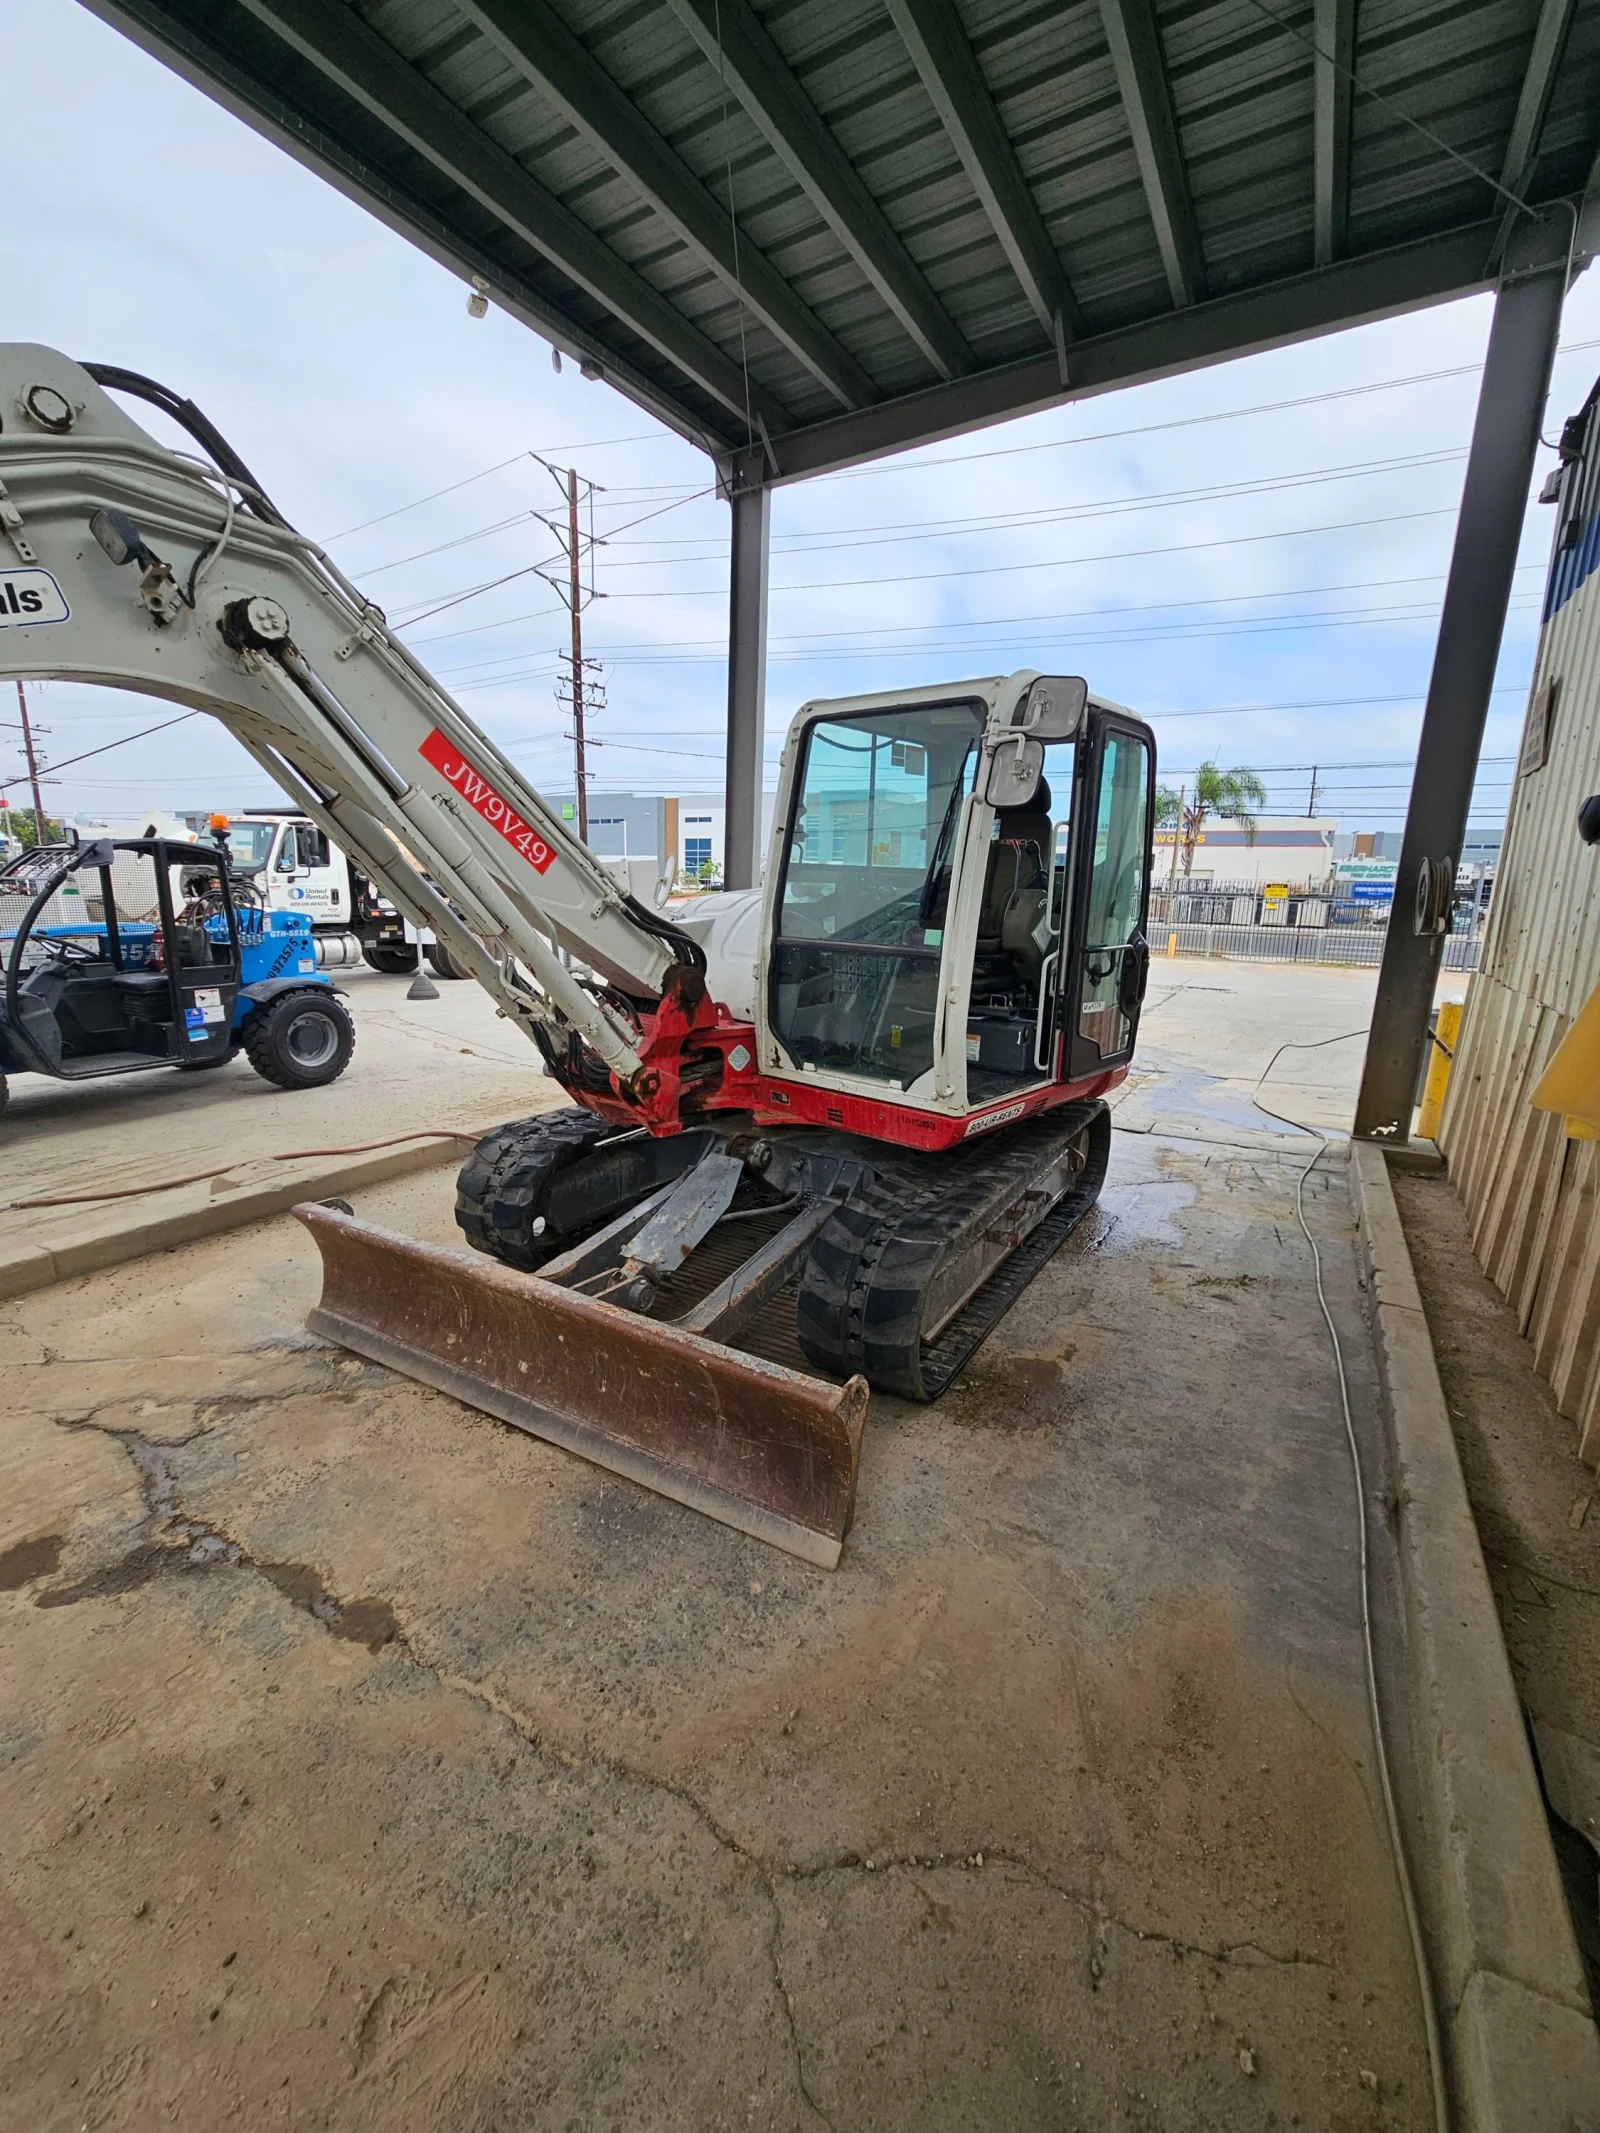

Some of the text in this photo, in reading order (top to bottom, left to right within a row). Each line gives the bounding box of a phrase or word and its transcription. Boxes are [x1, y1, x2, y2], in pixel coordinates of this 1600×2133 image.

[443, 761, 548, 865] JW9V49
[1155, 834, 1207, 844] WORS
[269, 929, 309, 938] GTH-5519
[968, 1106, 1022, 1133] 800-UR-RENTS
